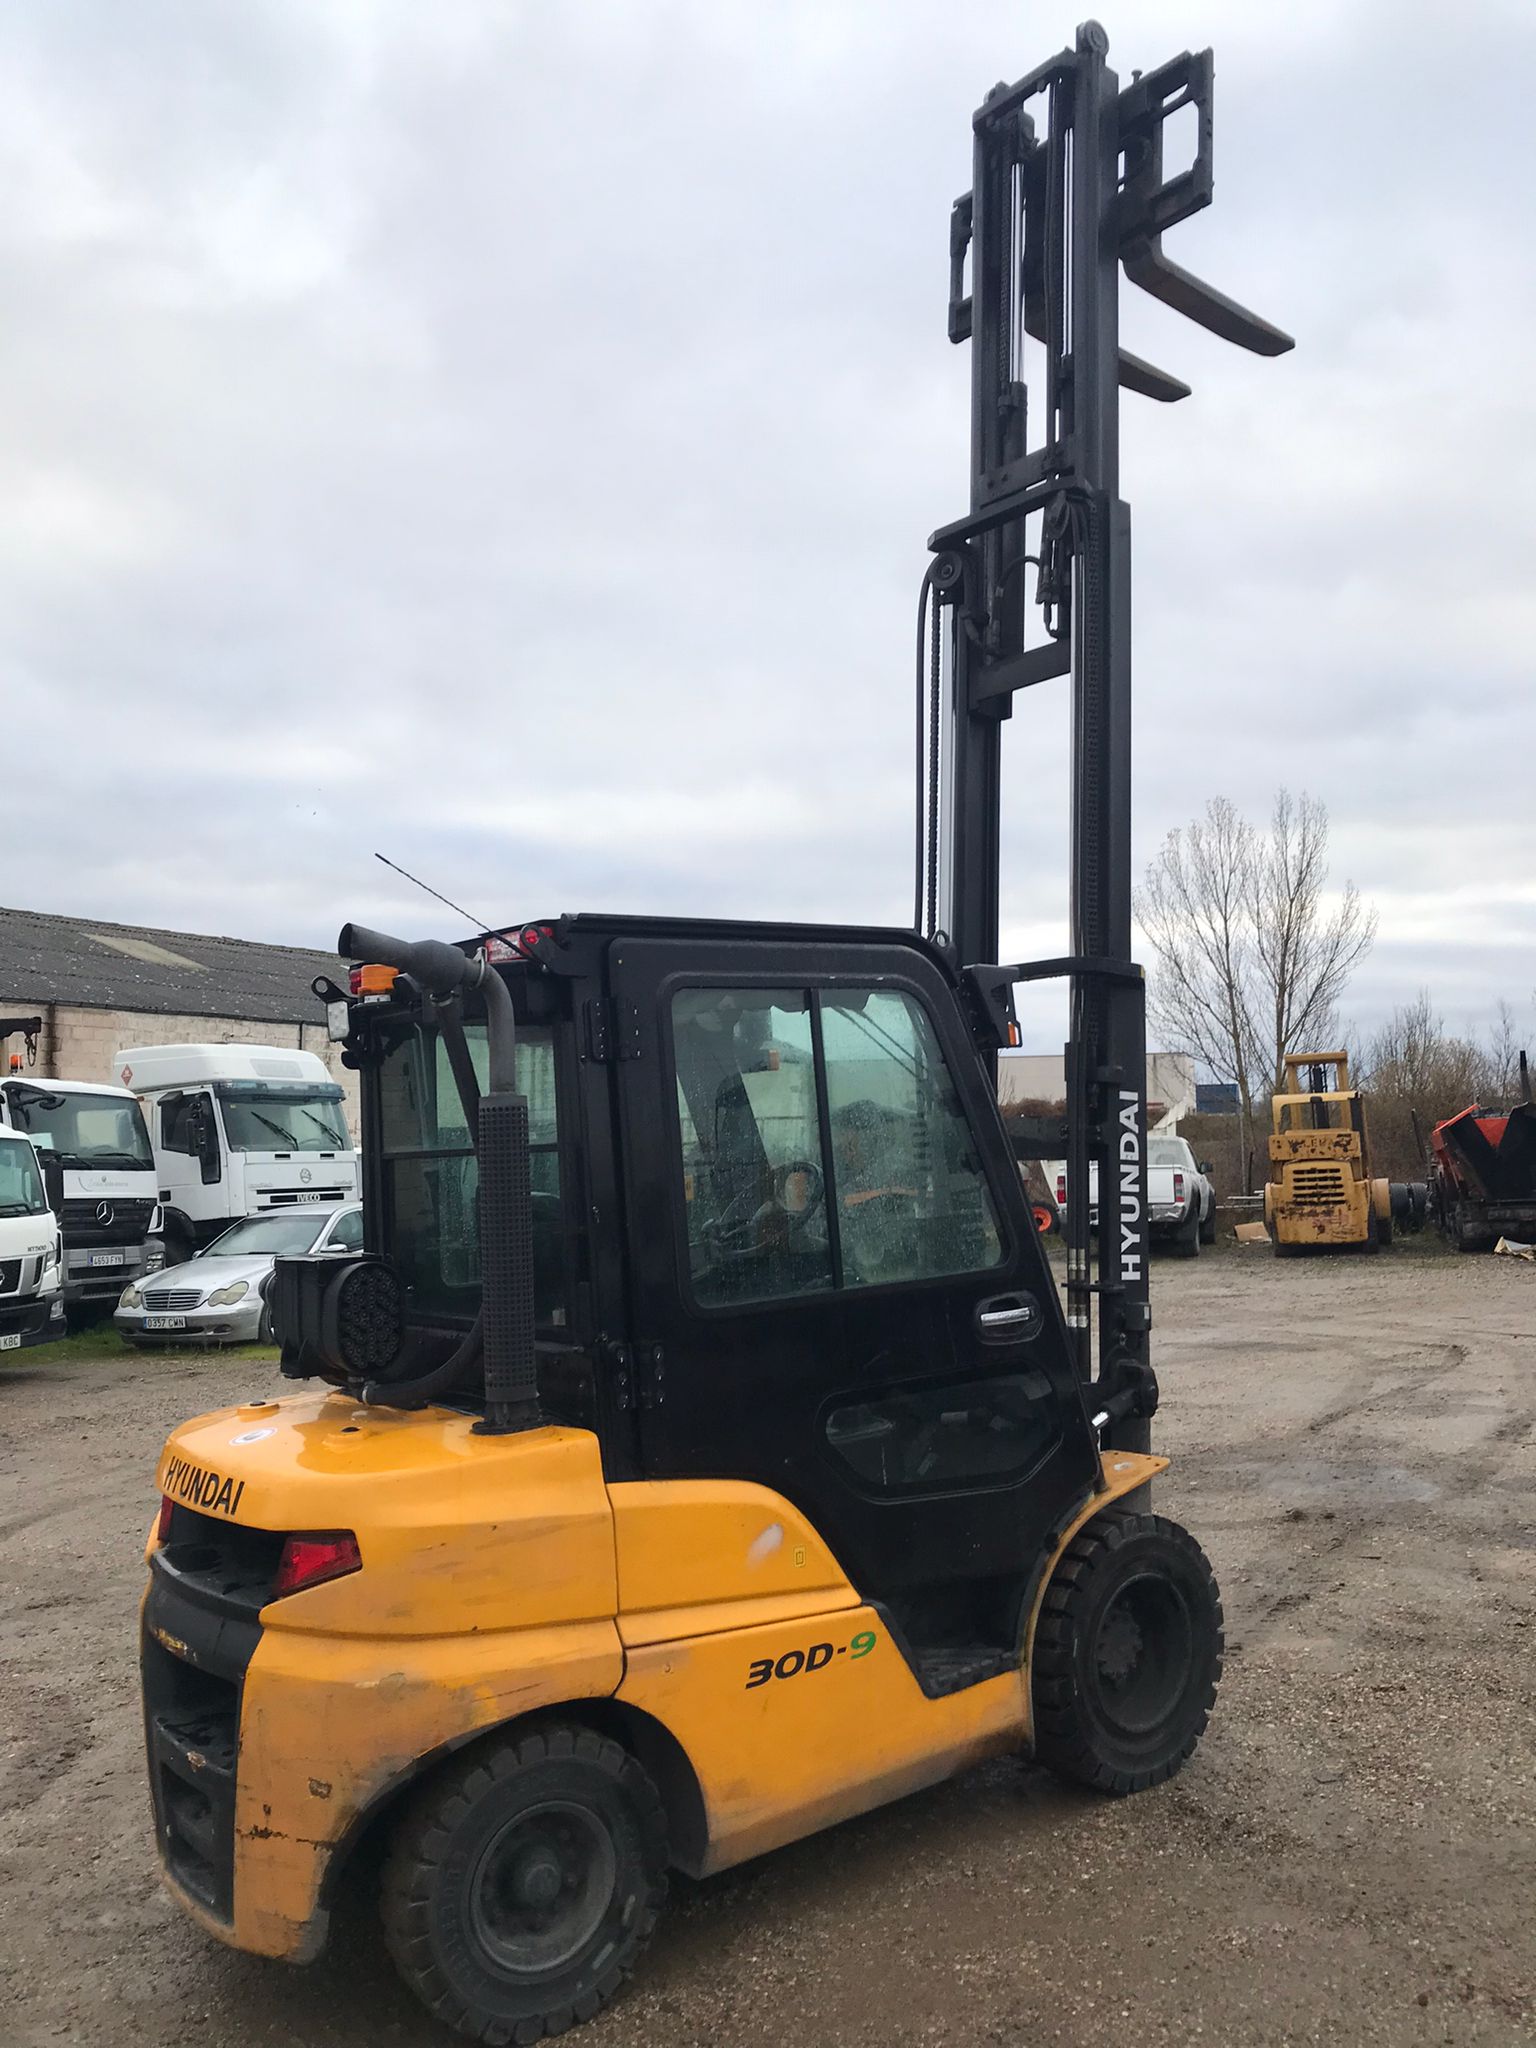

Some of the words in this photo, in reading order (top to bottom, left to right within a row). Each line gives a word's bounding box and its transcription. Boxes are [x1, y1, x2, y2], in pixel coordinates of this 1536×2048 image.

[297, 1193, 321, 1203] IVECO
[1119, 1090, 1141, 1280] HYUNDAI
[163, 1455, 245, 1516] HYUNDAI
[745, 1631, 877, 1690] 30D-9
